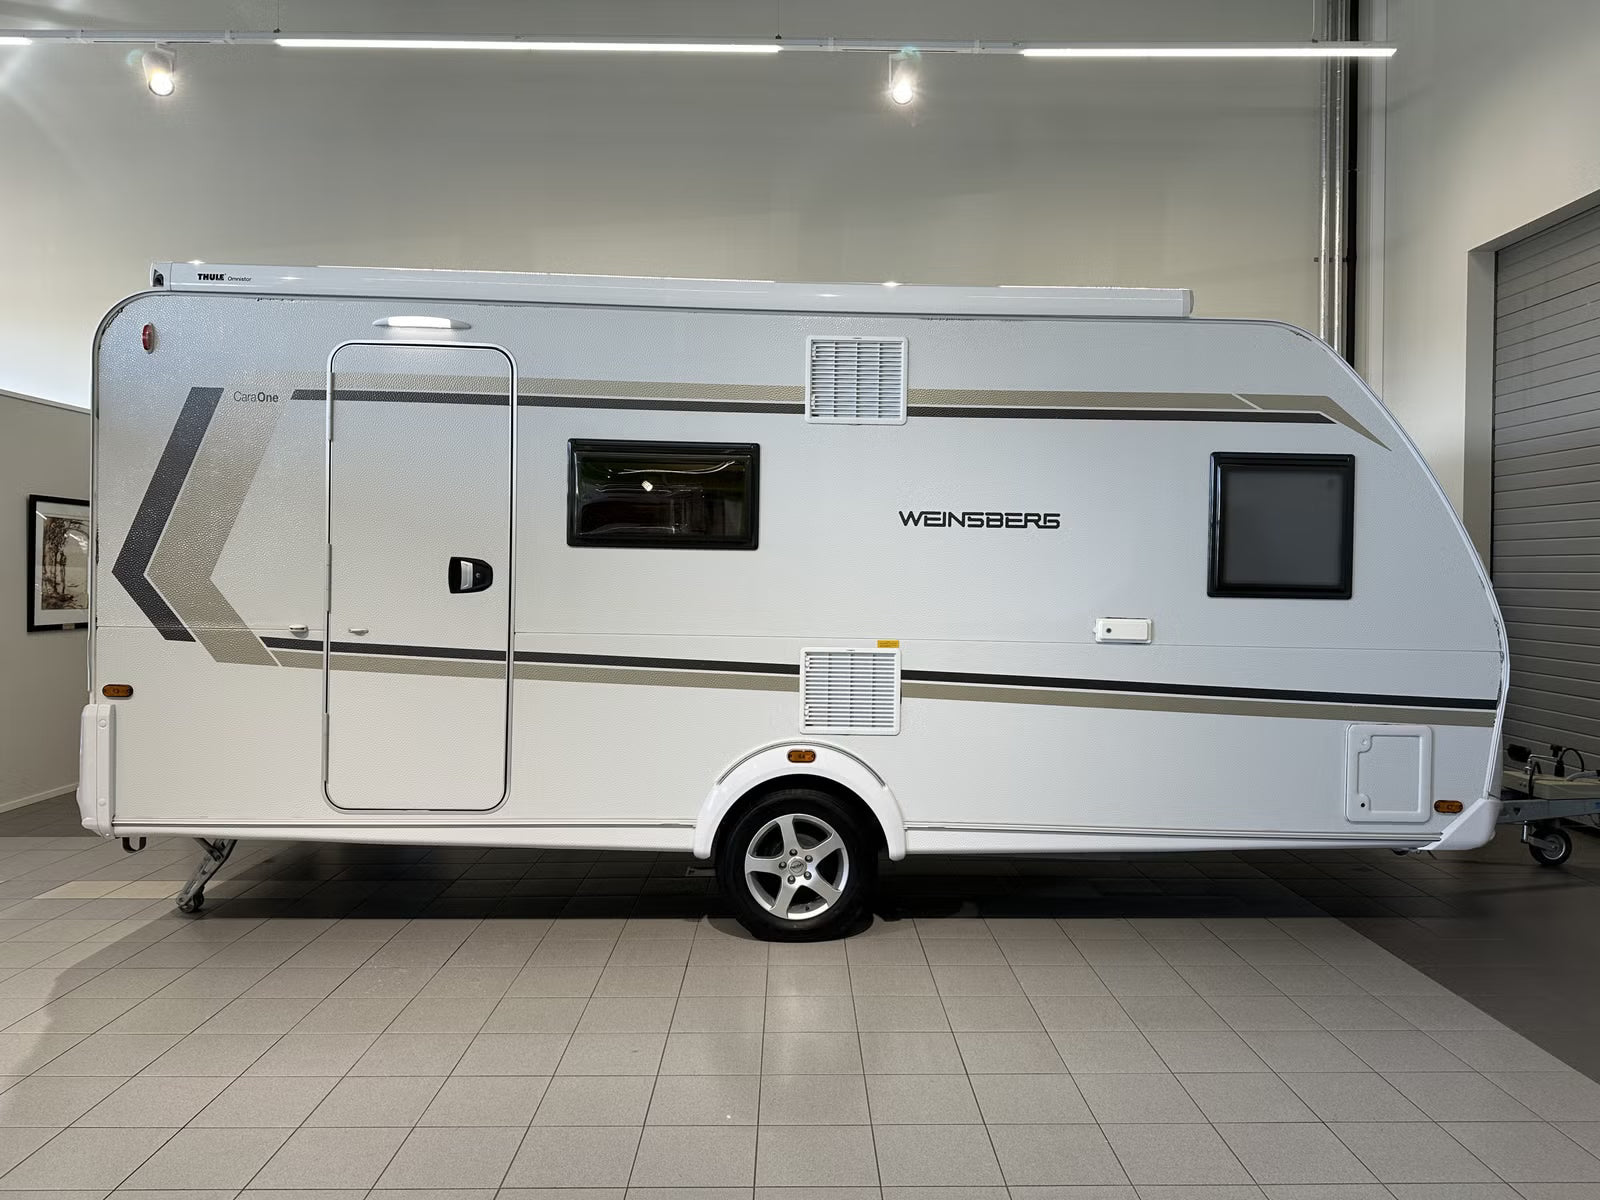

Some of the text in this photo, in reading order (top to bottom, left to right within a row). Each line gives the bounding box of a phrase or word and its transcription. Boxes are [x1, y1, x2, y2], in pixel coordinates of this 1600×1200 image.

[197, 273, 225, 281] THULE
[233, 390, 279, 403] CaraOne
[898, 510, 1061, 529] WEINSBERG
